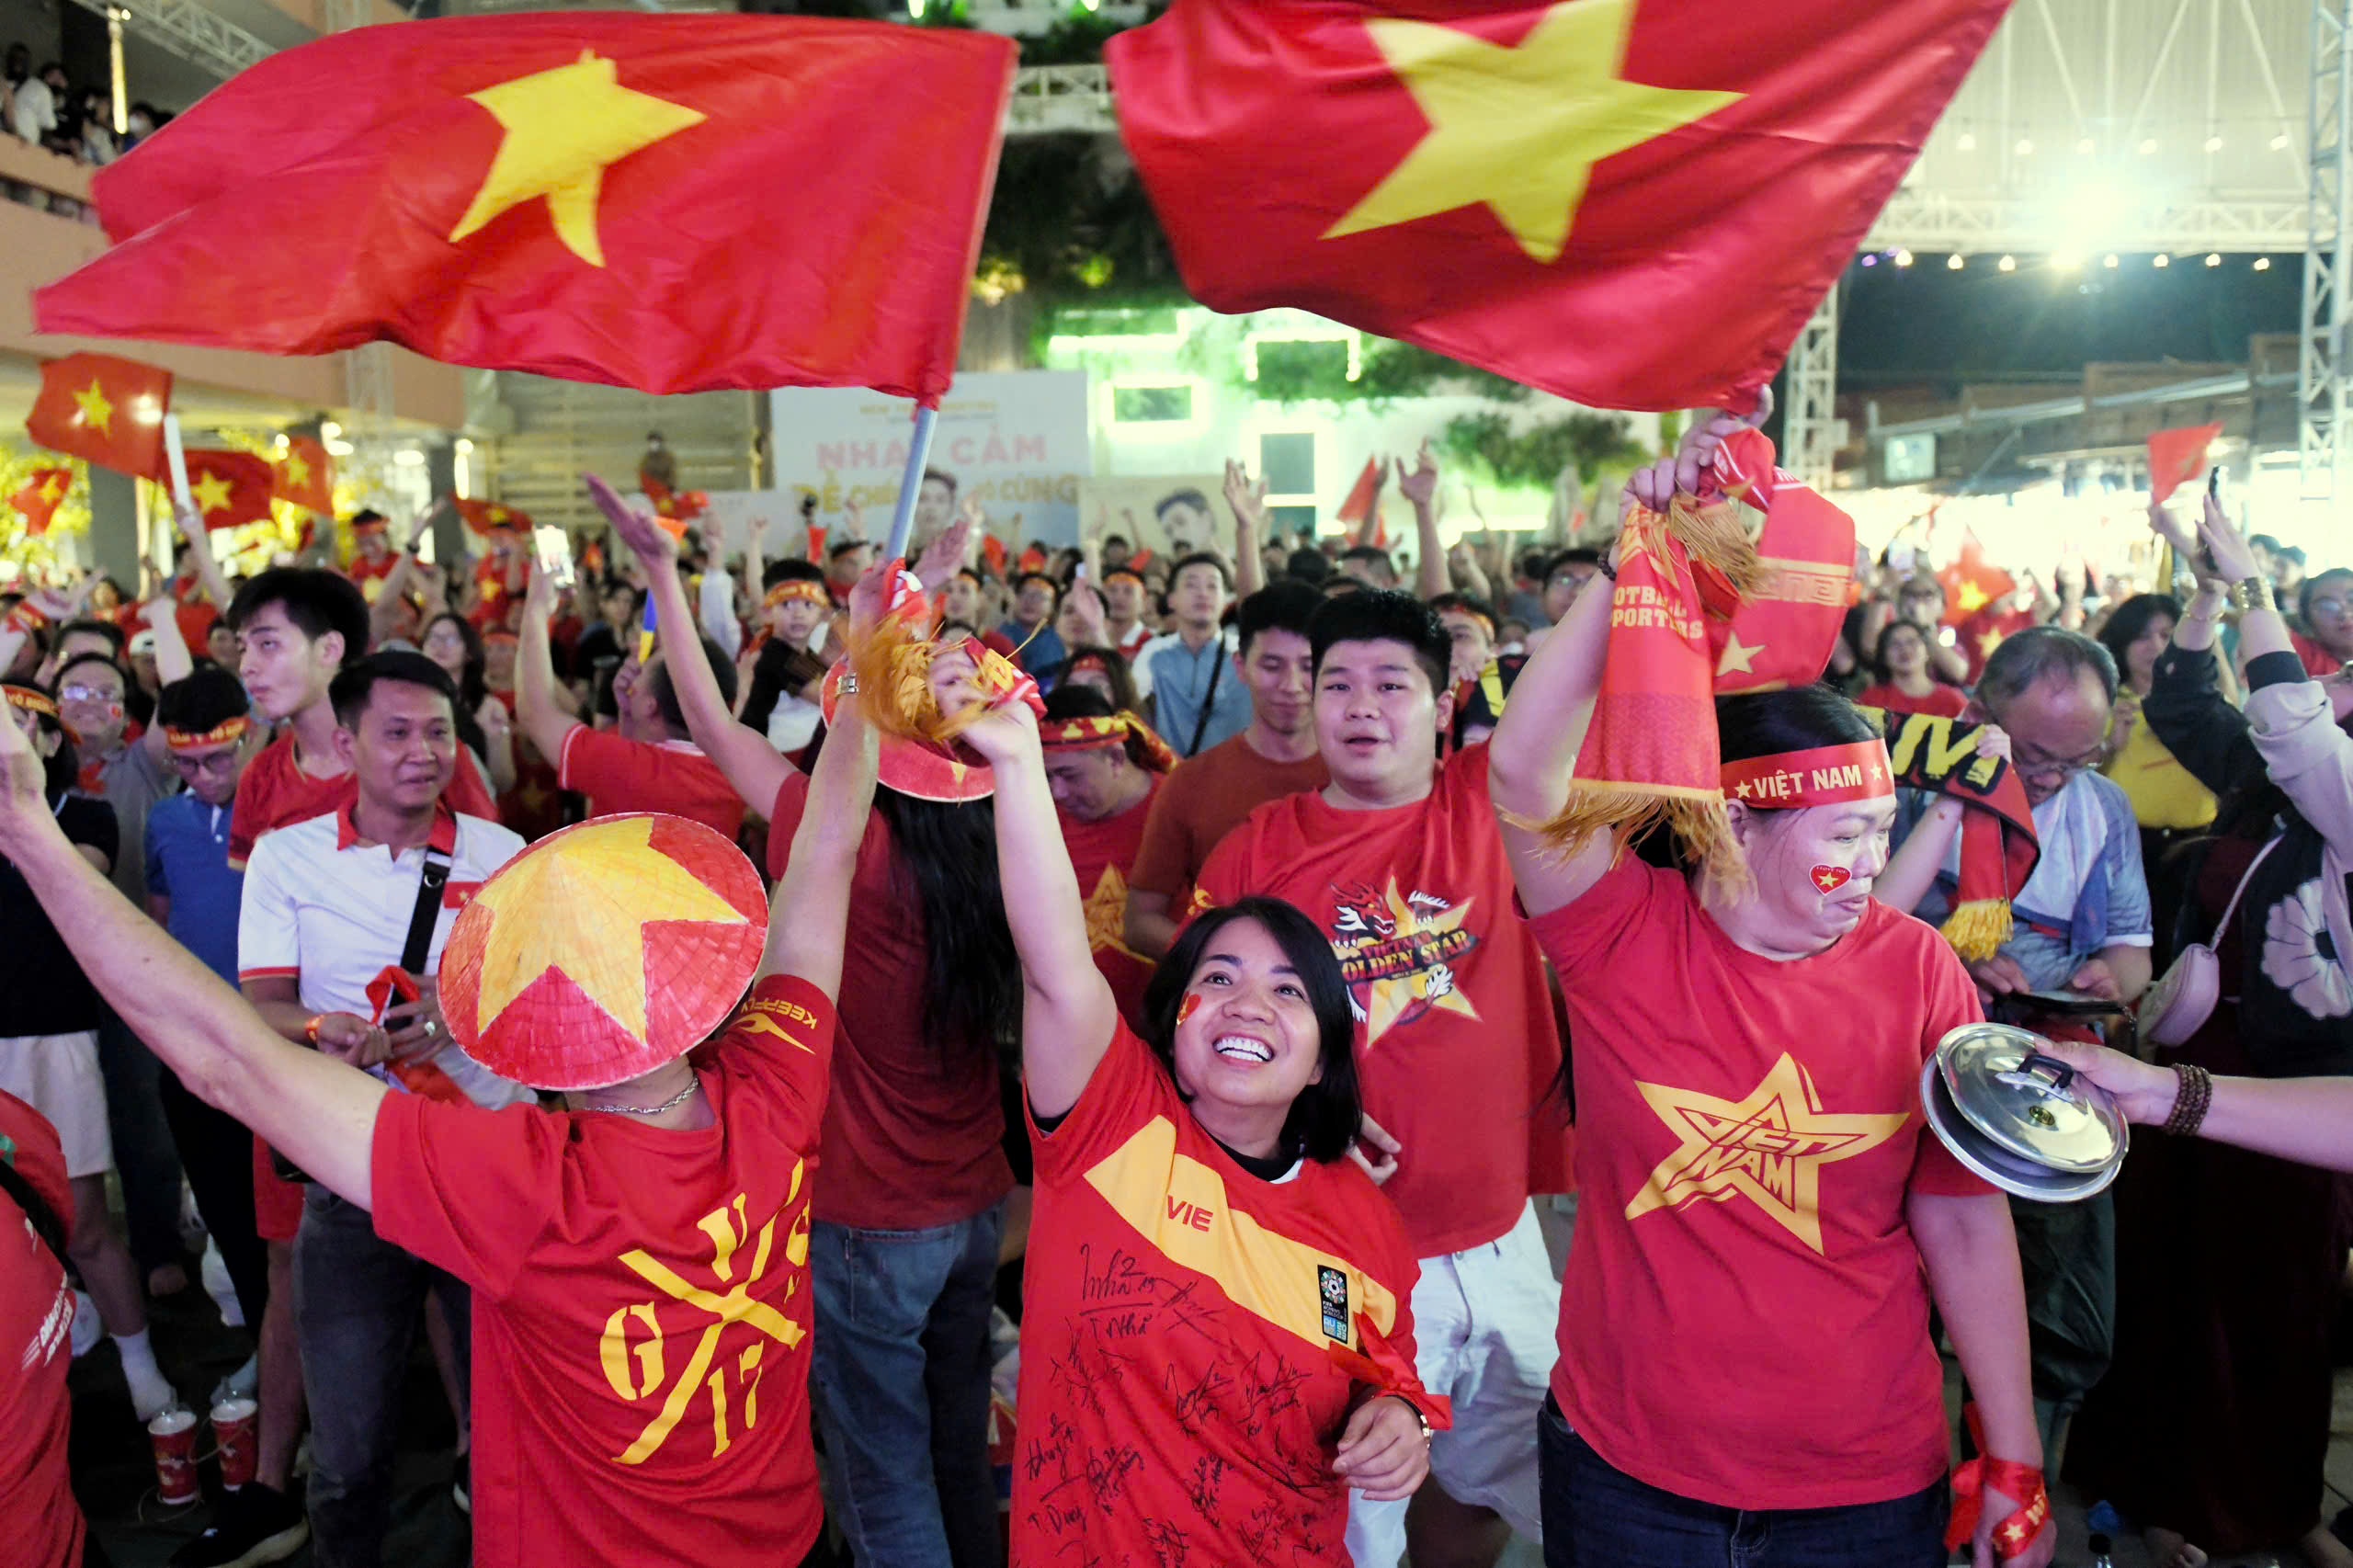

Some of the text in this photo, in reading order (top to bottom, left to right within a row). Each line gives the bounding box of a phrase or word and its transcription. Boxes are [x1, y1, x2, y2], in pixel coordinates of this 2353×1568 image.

[1754, 769, 1803, 800] VIỆT
[1812, 764, 1863, 791] NAM
[1341, 930, 1471, 982] OLDEN STAR
[1665, 1146, 1796, 1213] NAM
[1167, 1194, 1214, 1233] VIE
